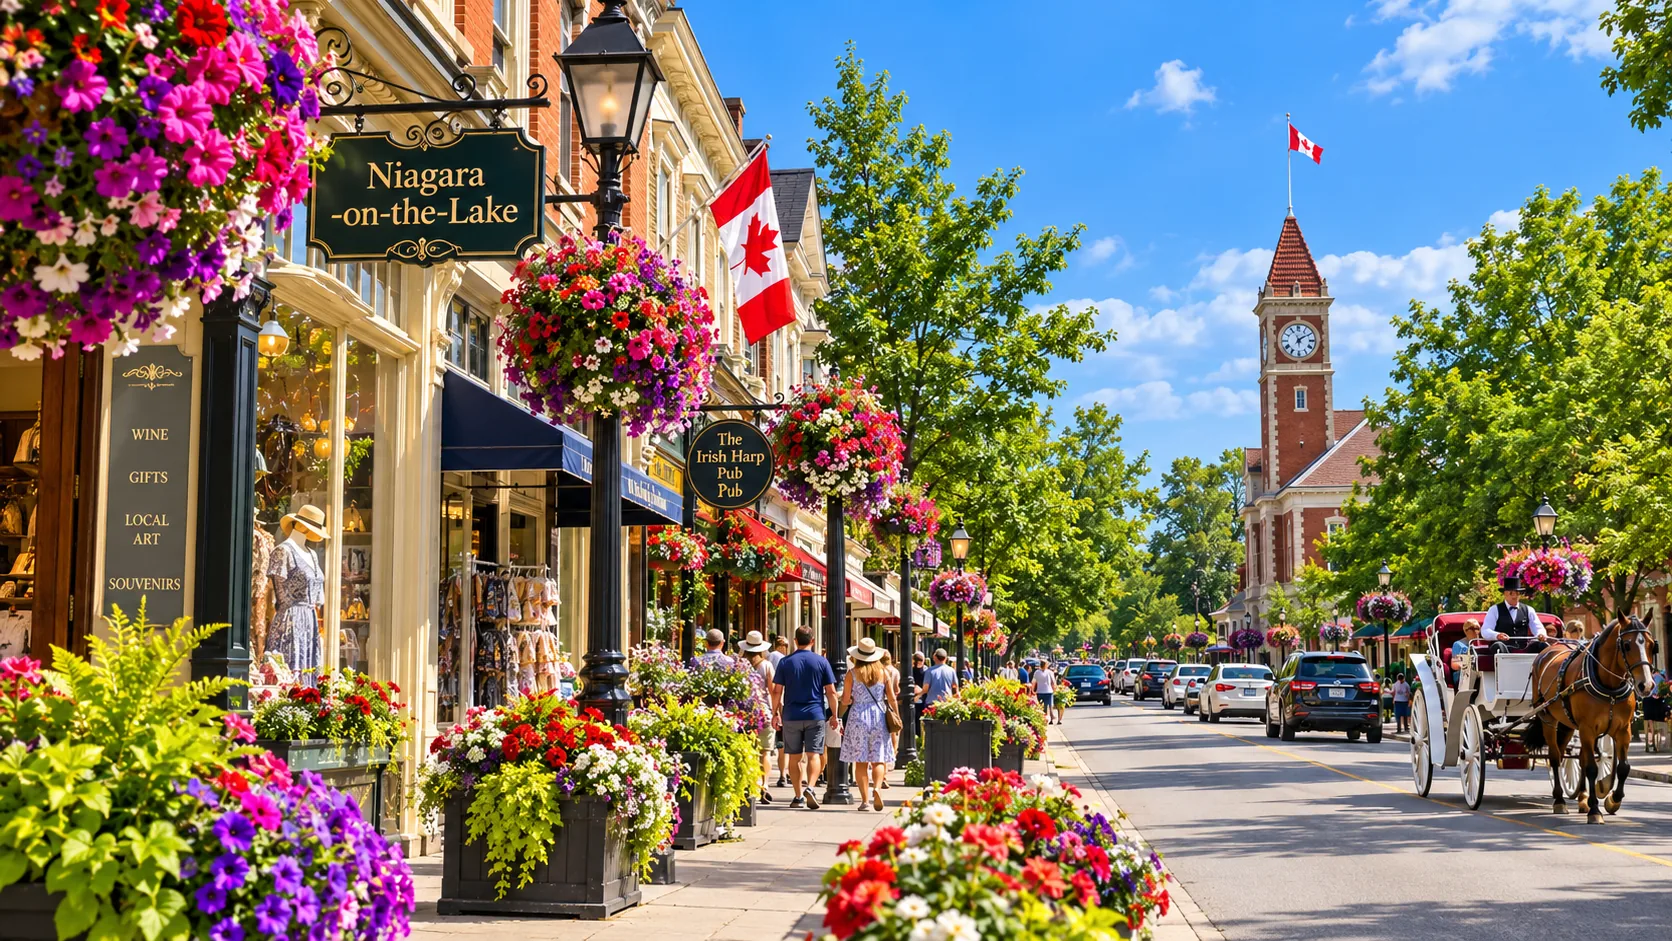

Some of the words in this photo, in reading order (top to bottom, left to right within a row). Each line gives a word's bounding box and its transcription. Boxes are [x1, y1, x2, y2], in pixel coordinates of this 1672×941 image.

[367, 161, 485, 196] Niagara
[331, 196, 519, 227] -on-the-Lake
[131, 428, 169, 441] WINE
[717, 431, 743, 446] The
[696, 449, 727, 463] Irish
[730, 449, 765, 466] Harp
[129, 470, 168, 484] GIFTS
[717, 466, 743, 480] Pub
[717, 482, 743, 498] Pub
[125, 513, 170, 527] LOCAL
[132, 532, 161, 546] ART
[108, 577, 181, 592] SOUVENIRS
